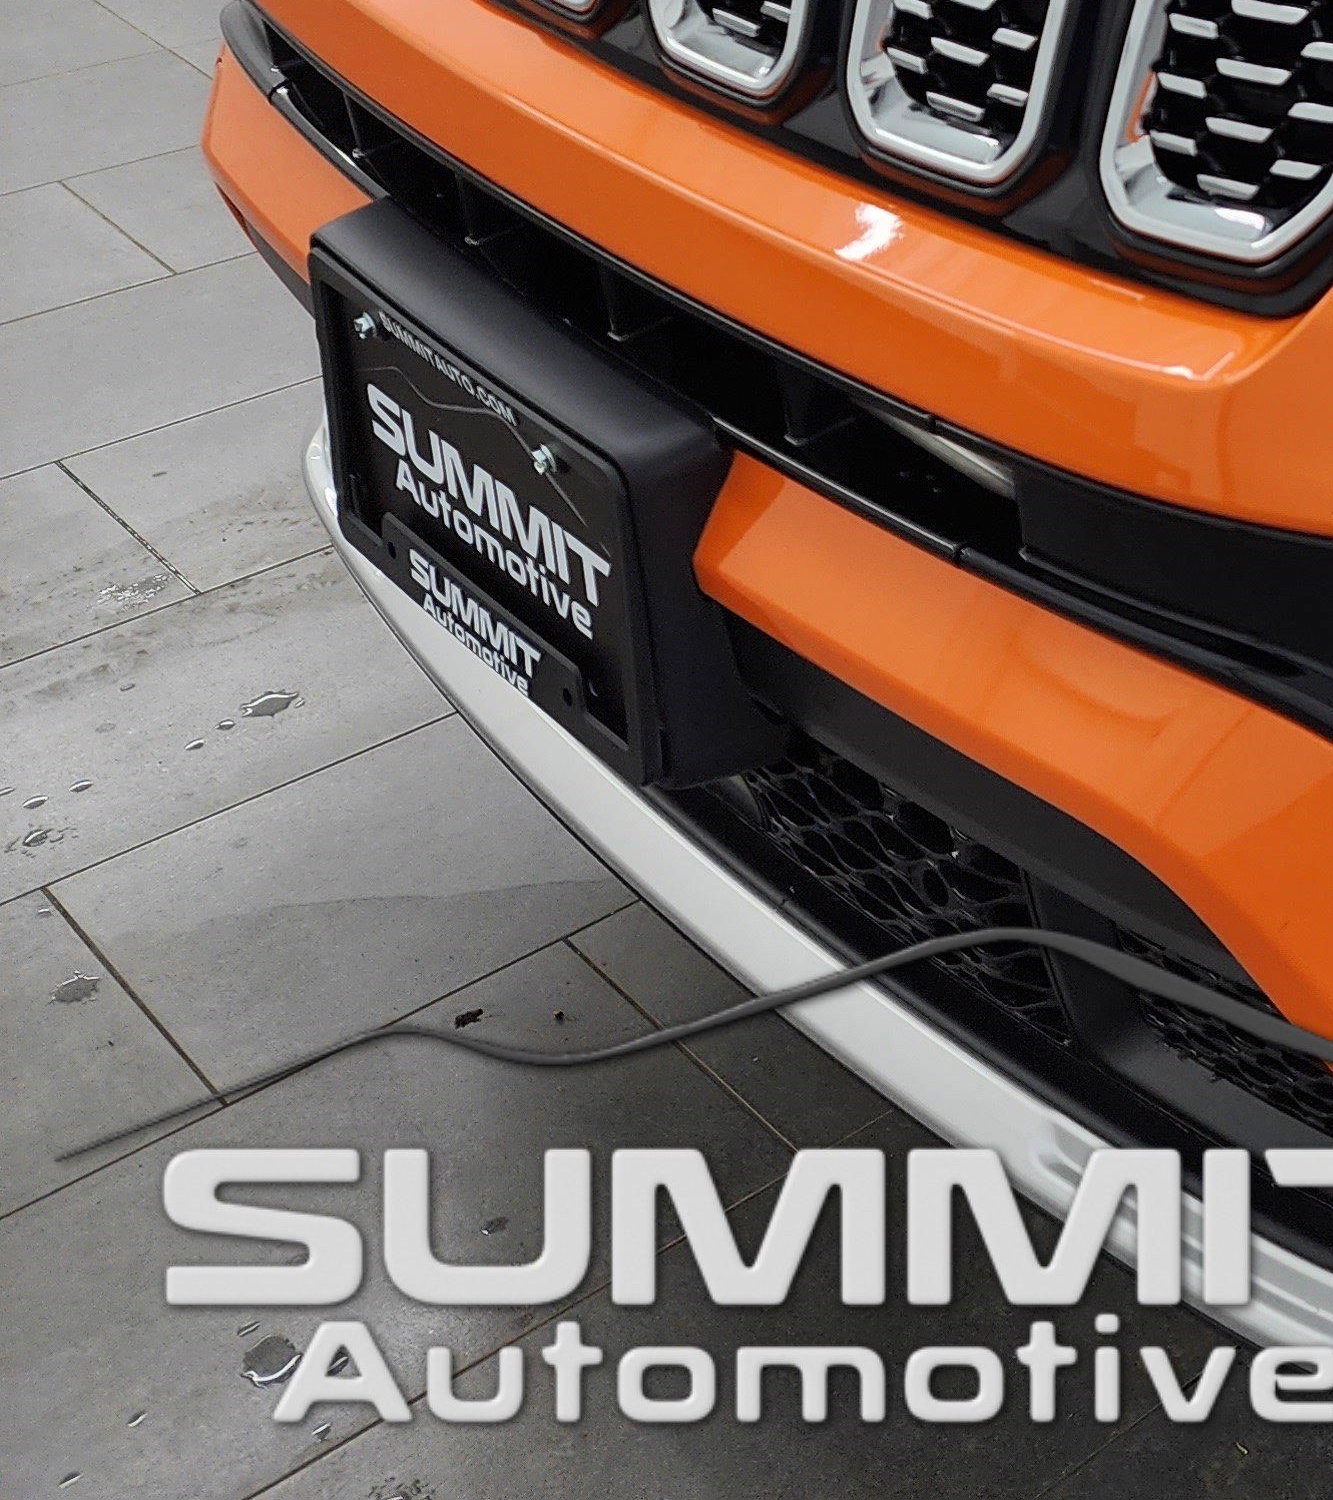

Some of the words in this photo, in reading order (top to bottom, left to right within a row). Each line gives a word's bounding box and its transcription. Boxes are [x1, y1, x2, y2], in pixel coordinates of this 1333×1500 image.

[378, 310, 518, 427] SUMMITAUTO.COM
[366, 382, 612, 608] SUMMIT
[395, 458, 594, 641] Automotive
[409, 548, 542, 679] SUMMIT
[422, 592, 529, 698] Automotive
